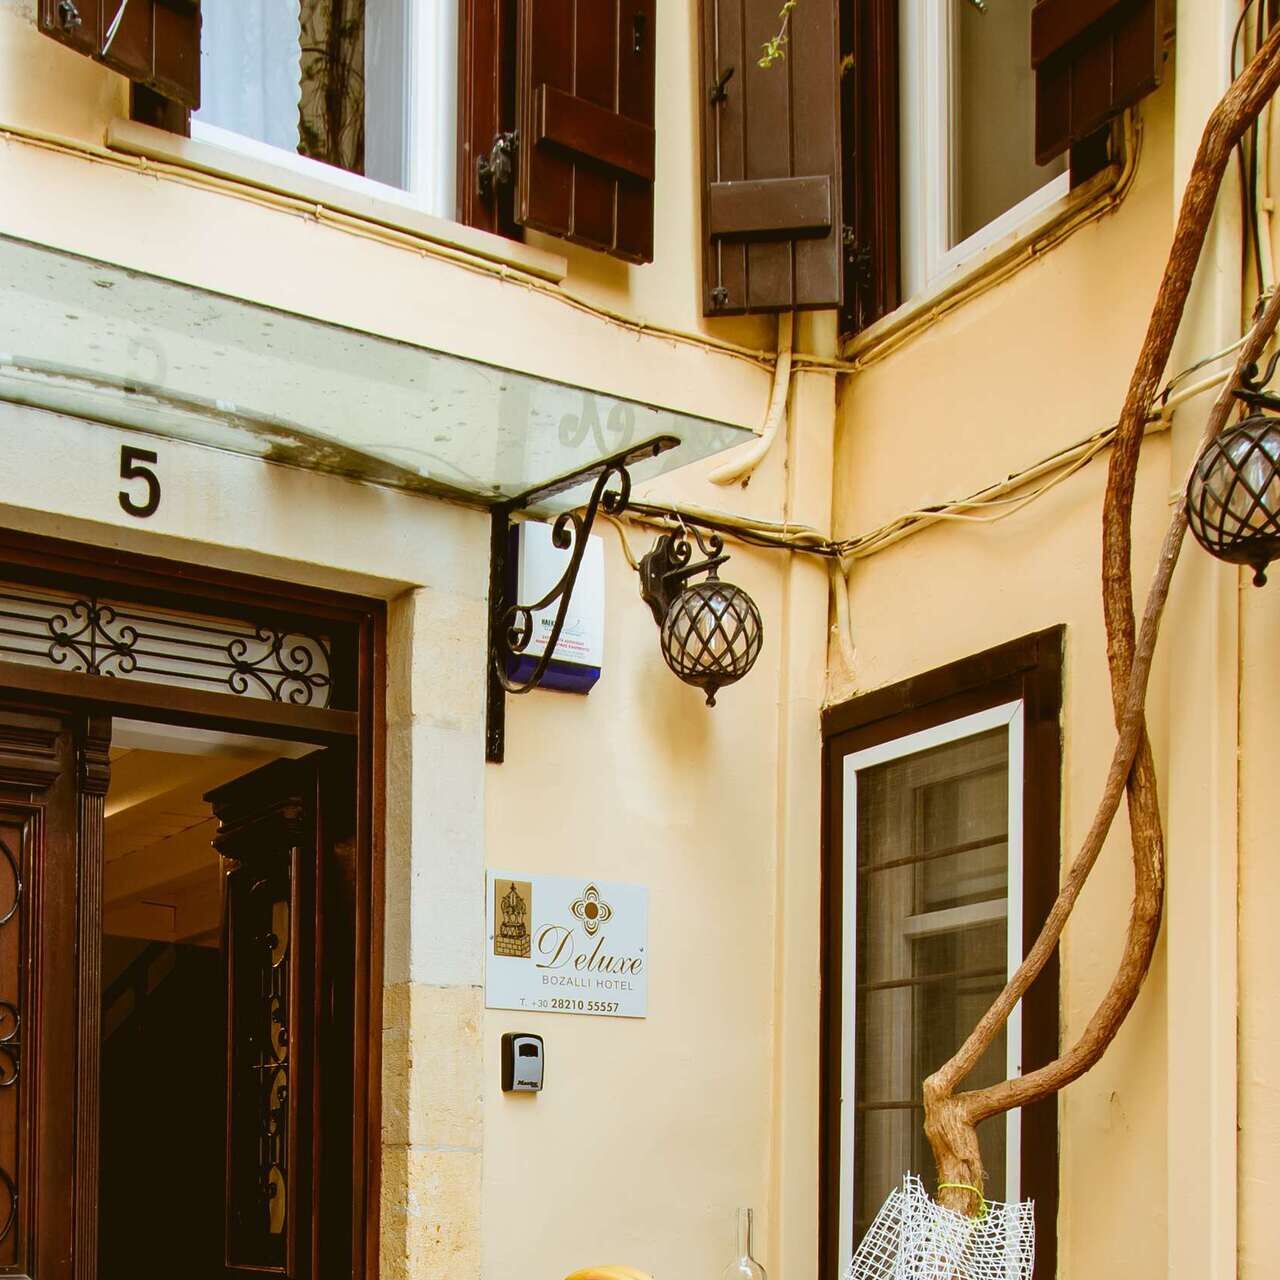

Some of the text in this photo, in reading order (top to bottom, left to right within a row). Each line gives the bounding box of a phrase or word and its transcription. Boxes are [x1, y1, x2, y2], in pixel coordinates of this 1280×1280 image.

[119, 444, 161, 518] 5
[533, 923, 644, 976] Deluxe
[542, 975, 633, 991] BOZALLI HOTEL
[531, 999, 548, 1008] +30
[551, 998, 584, 1010] 28210
[587, 1000, 619, 1013] 55557
